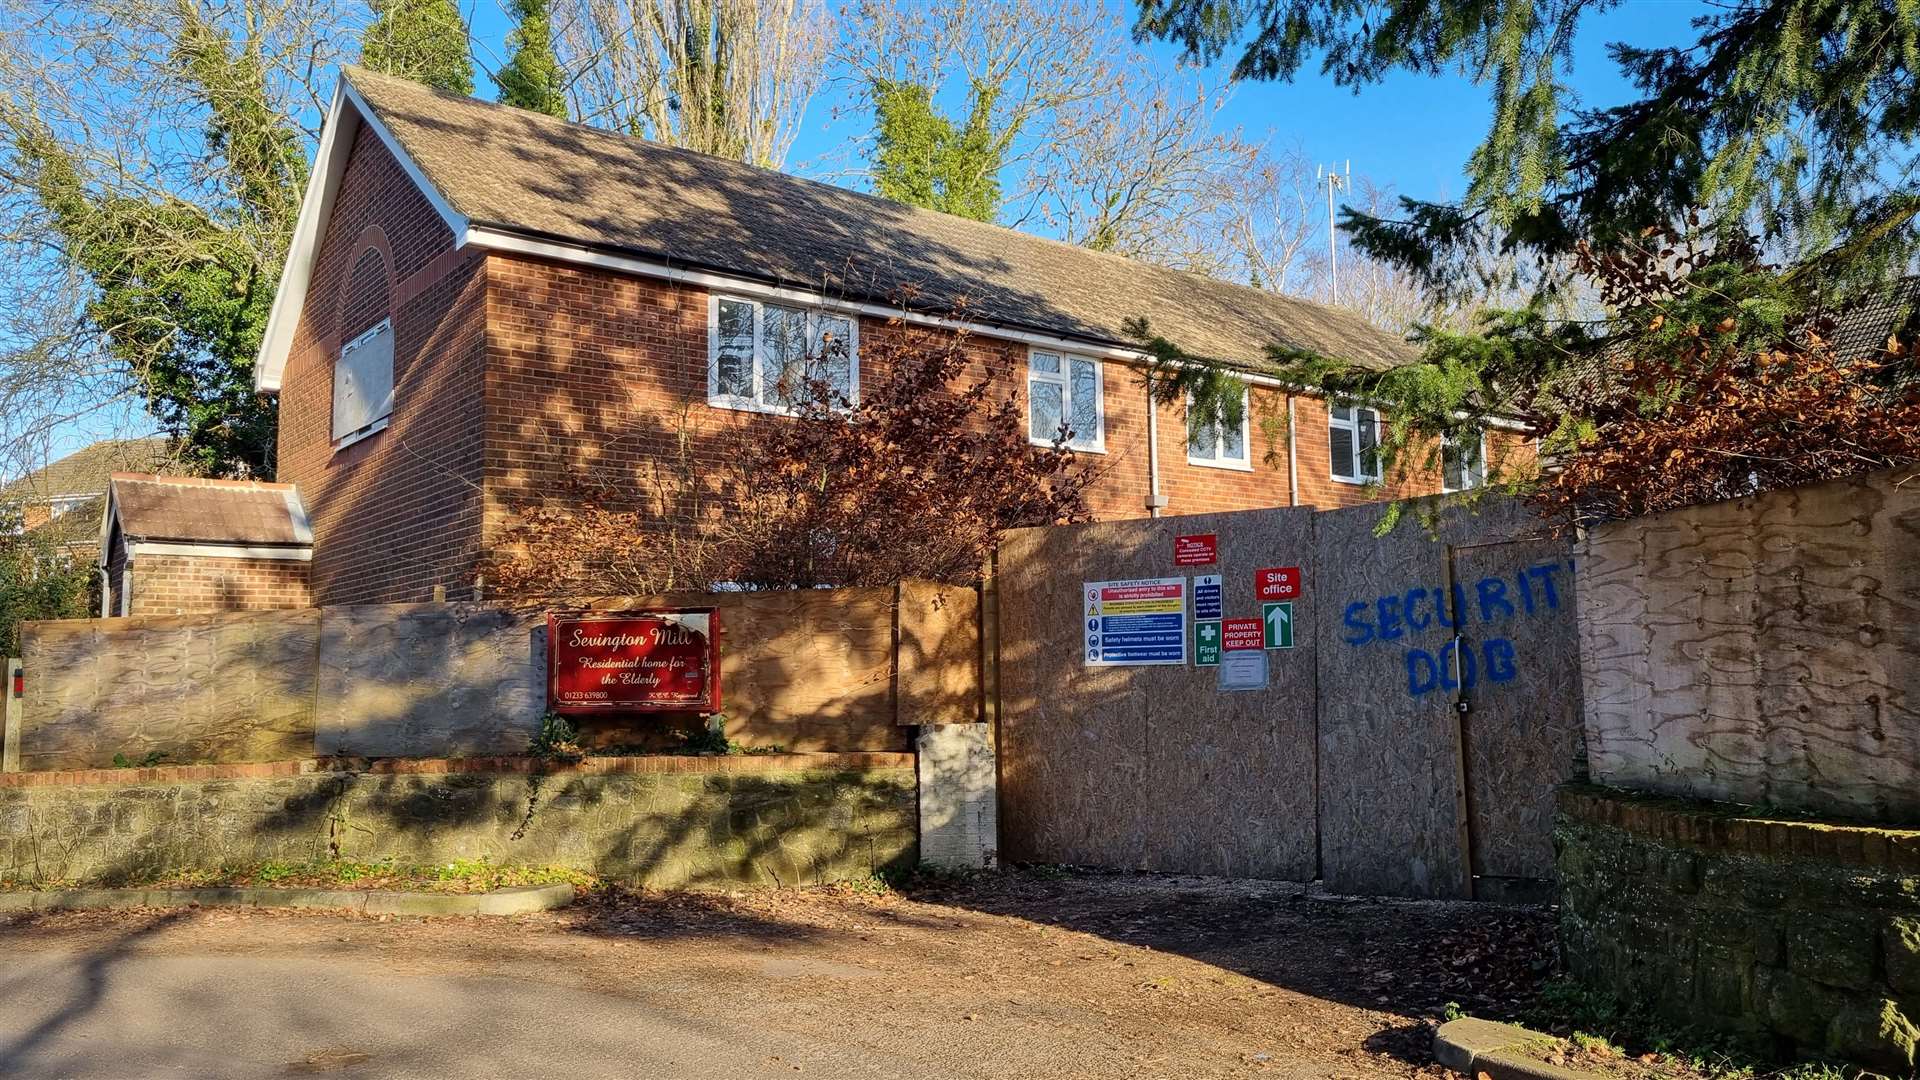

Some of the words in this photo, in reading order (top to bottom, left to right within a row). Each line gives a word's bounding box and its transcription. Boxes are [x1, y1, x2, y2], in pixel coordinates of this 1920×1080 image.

[1267, 573, 1288, 583] Site
[1263, 585, 1292, 594] office
[1343, 559, 1576, 647] SECURIT
[1228, 623, 1257, 631] PRIVATE
[1225, 631, 1262, 639] PROPERTY
[569, 628, 647, 652] Sevington
[650, 627, 692, 645] Mill
[1226, 639, 1244, 647] KEEP
[1200, 645, 1217, 653] First
[1203, 654, 1214, 662] aid
[579, 656, 640, 669] Residential
[640, 655, 667, 668] home
[668, 655, 686, 671] for
[601, 673, 617, 685] the
[619, 672, 660, 687] Elderly
[564, 691, 584, 699] 01233
[584, 691, 608, 699] 639800
